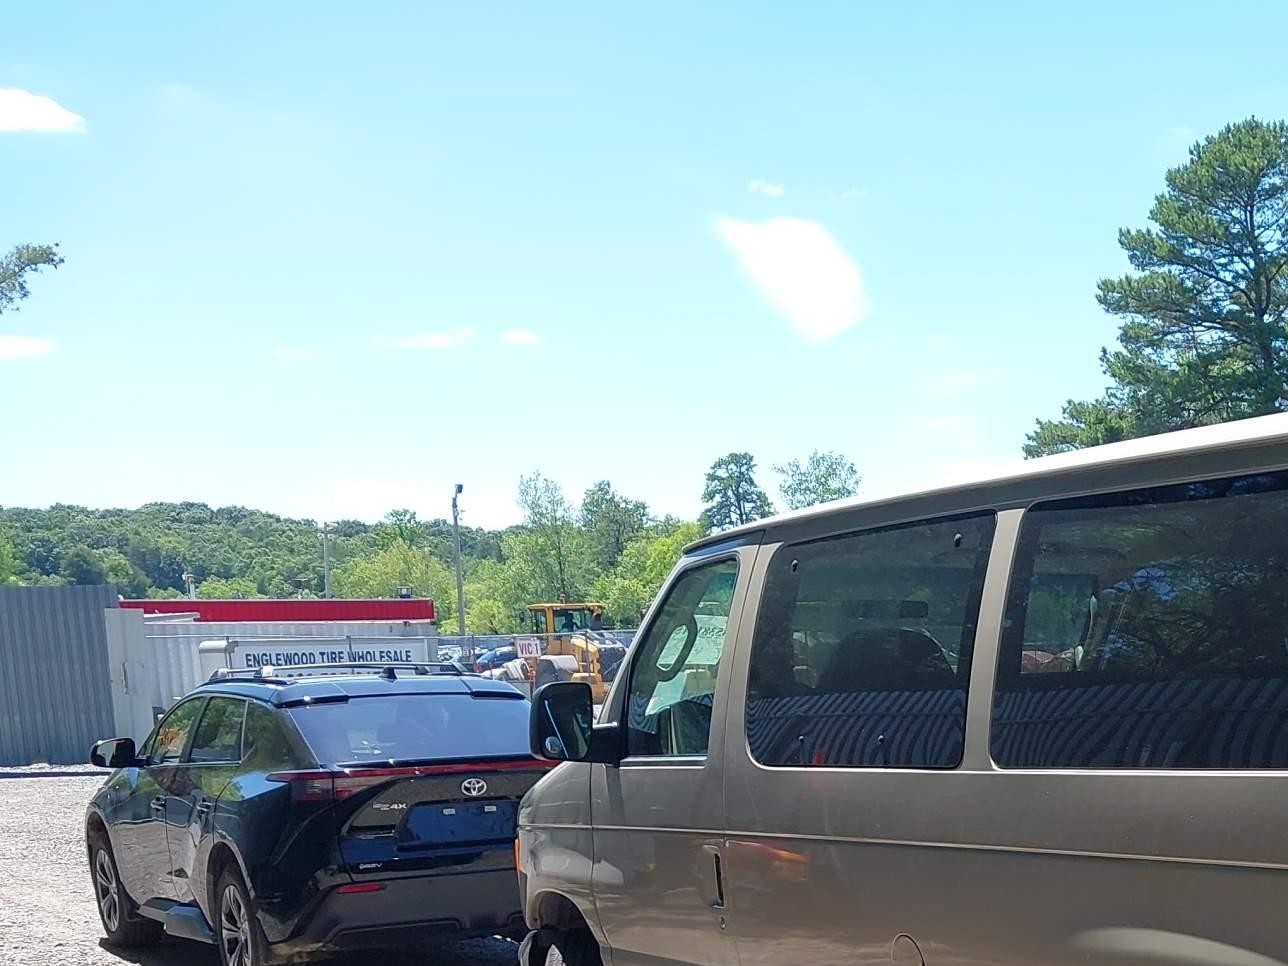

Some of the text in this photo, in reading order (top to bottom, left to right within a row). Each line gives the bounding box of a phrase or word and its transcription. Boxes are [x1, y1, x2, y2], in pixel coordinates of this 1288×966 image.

[519, 642, 539, 655] VIC 1
[245, 650, 412, 668] ENGLEWOOD TIRE WHOLESALE
